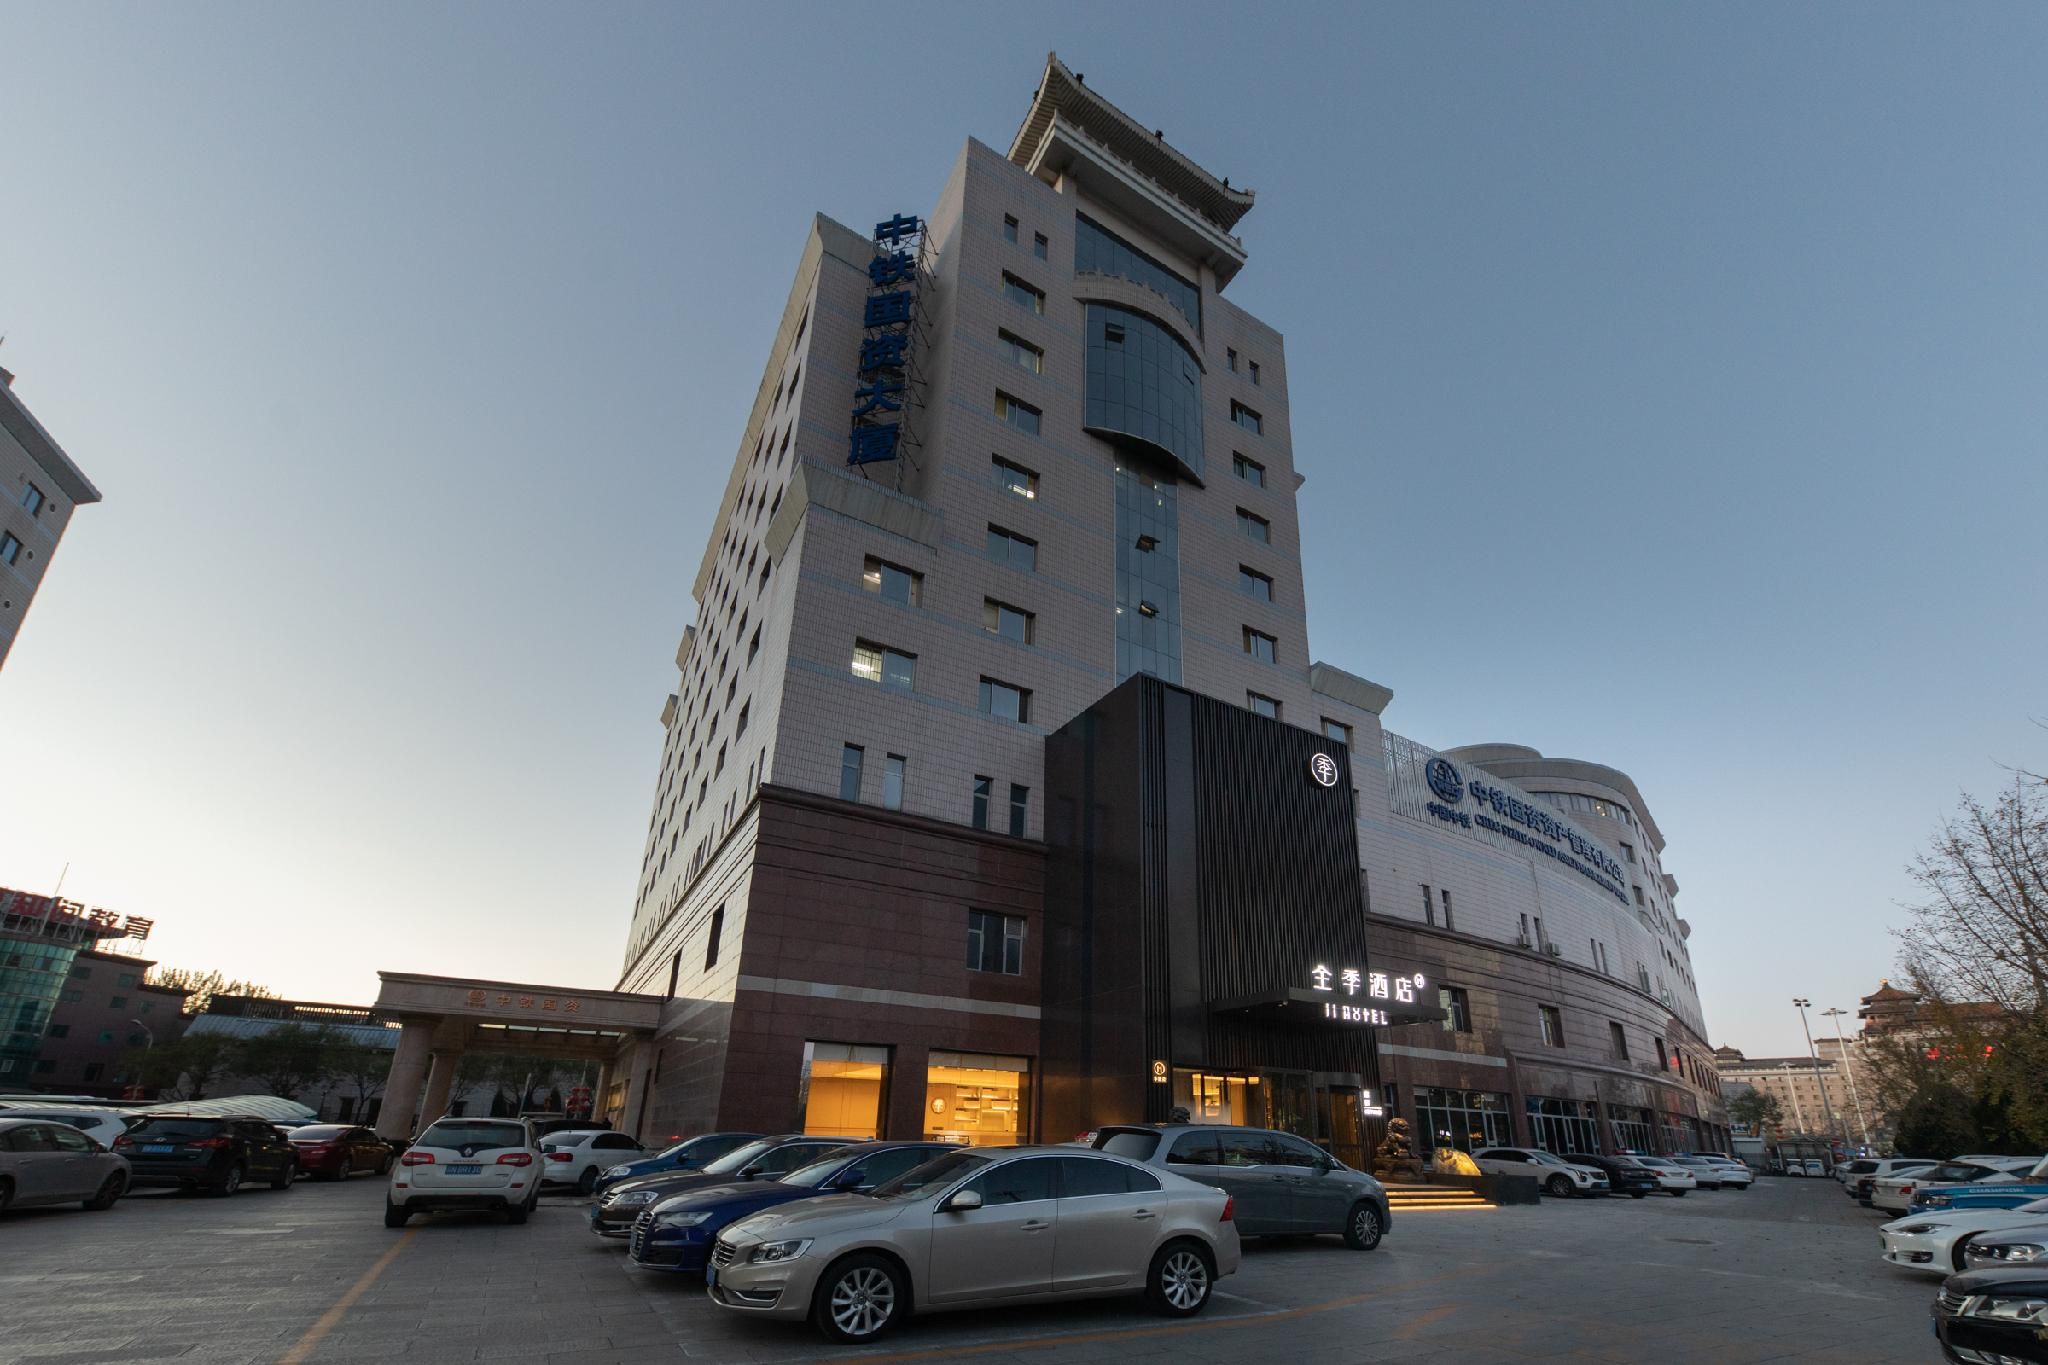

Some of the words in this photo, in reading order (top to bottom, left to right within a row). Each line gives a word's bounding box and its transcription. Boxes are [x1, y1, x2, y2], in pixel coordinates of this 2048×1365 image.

[847, 213, 918, 465] 中铁国资大厦
[1316, 757, 1333, 783] 季
[1312, 964, 1413, 1003] 全季酒店
